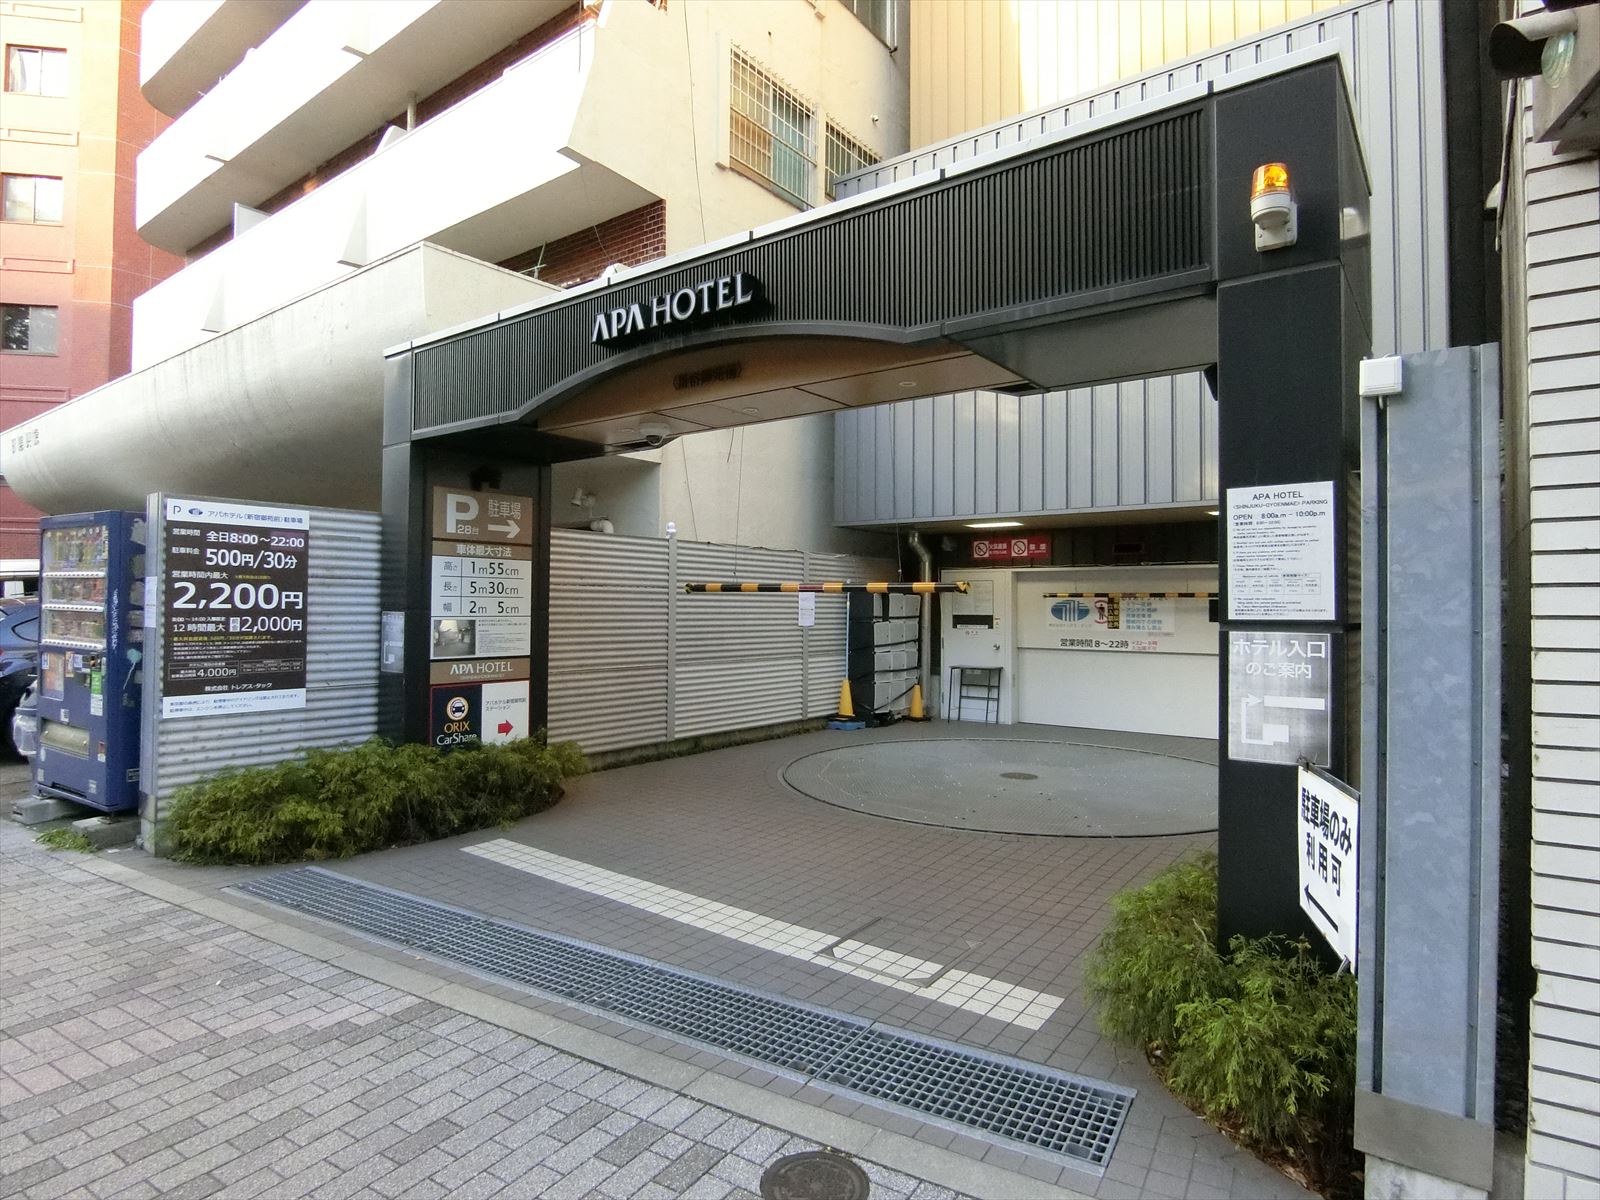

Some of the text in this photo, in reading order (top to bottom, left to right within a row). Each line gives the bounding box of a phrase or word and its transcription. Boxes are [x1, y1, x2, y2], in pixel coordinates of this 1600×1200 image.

[591, 272, 753, 343] APA HOTEL
[1252, 490, 1304, 501] APA HOTEL
[447, 494, 479, 533] P
[488, 499, 521, 520] 駐車場
[457, 525, 479, 535] 28台
[456, 544, 512, 557] 車体最大寸法
[172, 581, 303, 609] 2,200円
[241, 616, 302, 633] 2,000円
[1232, 638, 1326, 659] ホテル入口
[196, 667, 237, 678] 4,000円
[450, 661, 513, 675] APA HOTEL
[1245, 661, 1312, 679] のご案内
[444, 720, 470, 734] ORIX
[1301, 786, 1353, 856] 駐車場のみ
[1305, 831, 1343, 898] 利用可
